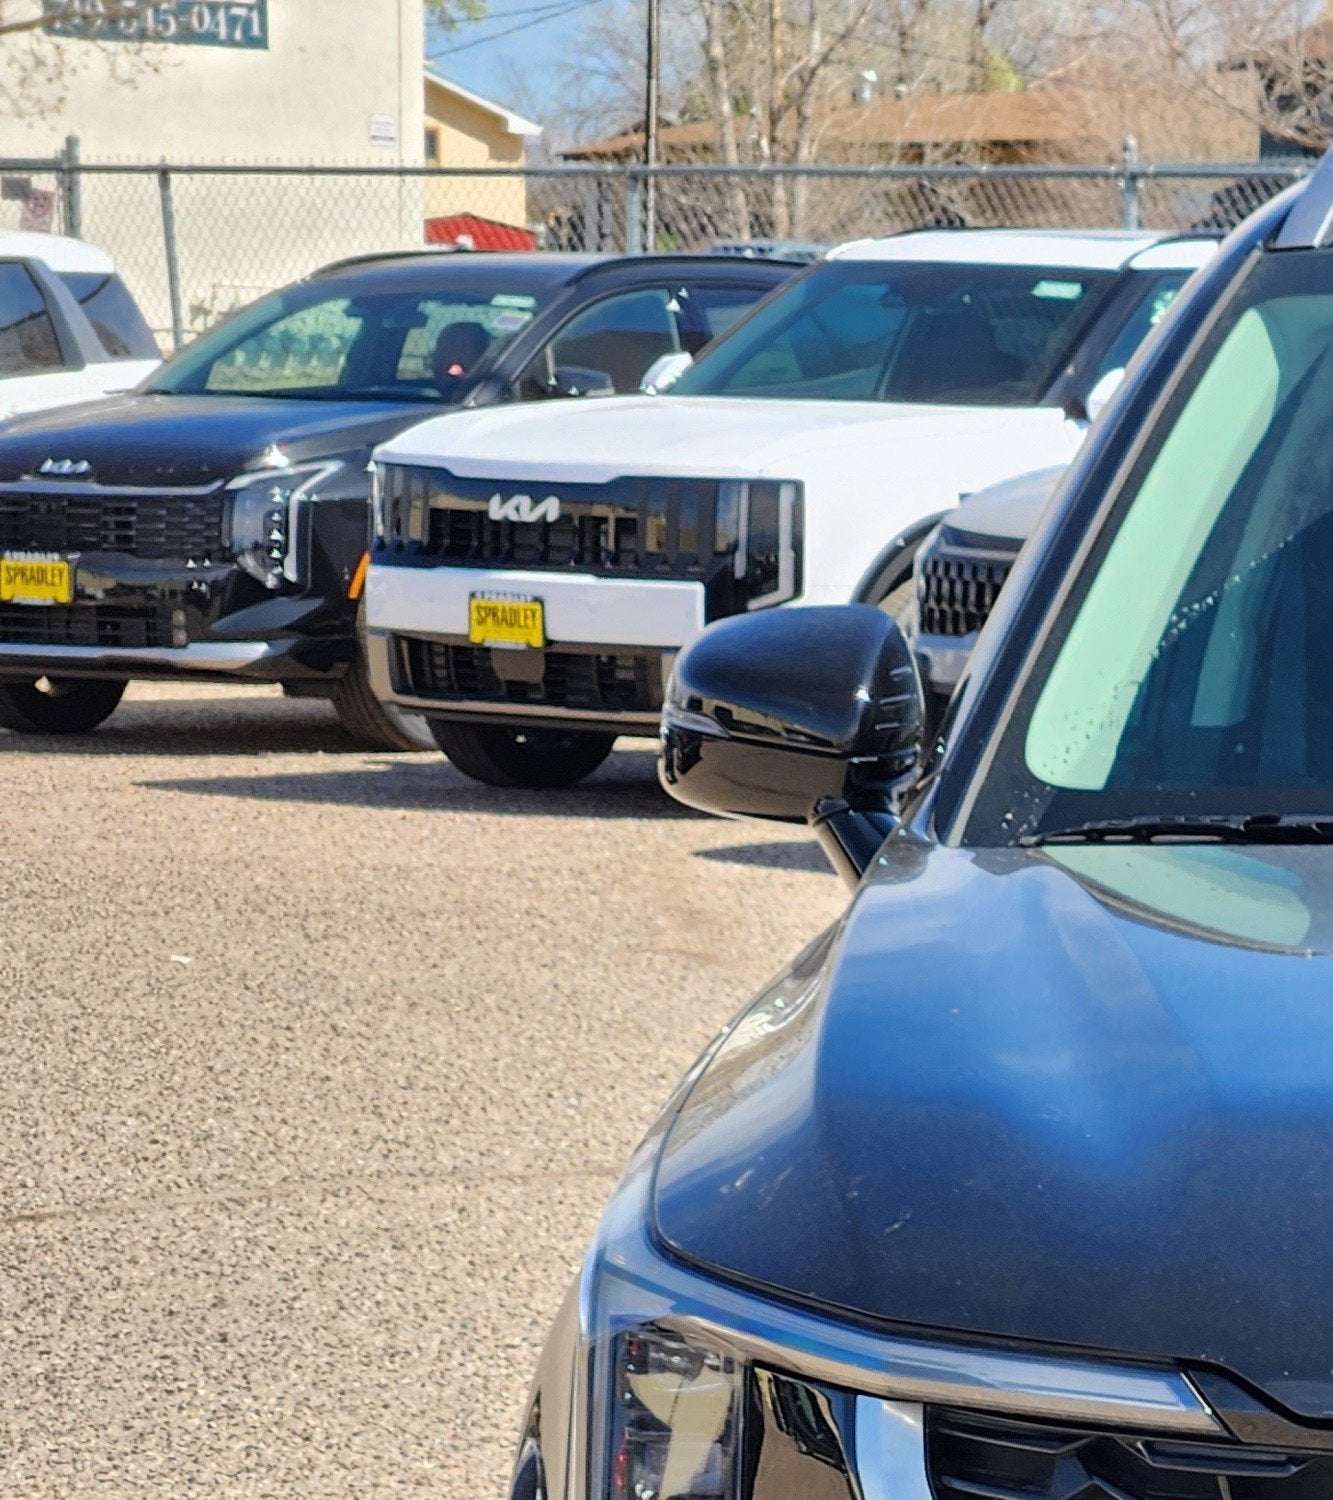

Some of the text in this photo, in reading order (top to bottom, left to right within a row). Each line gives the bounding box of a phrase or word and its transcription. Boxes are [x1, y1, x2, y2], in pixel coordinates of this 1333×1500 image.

[488, 492, 560, 523] KIA
[5, 565, 65, 587] SPRADLEY
[475, 604, 538, 630] SPRADLEY
